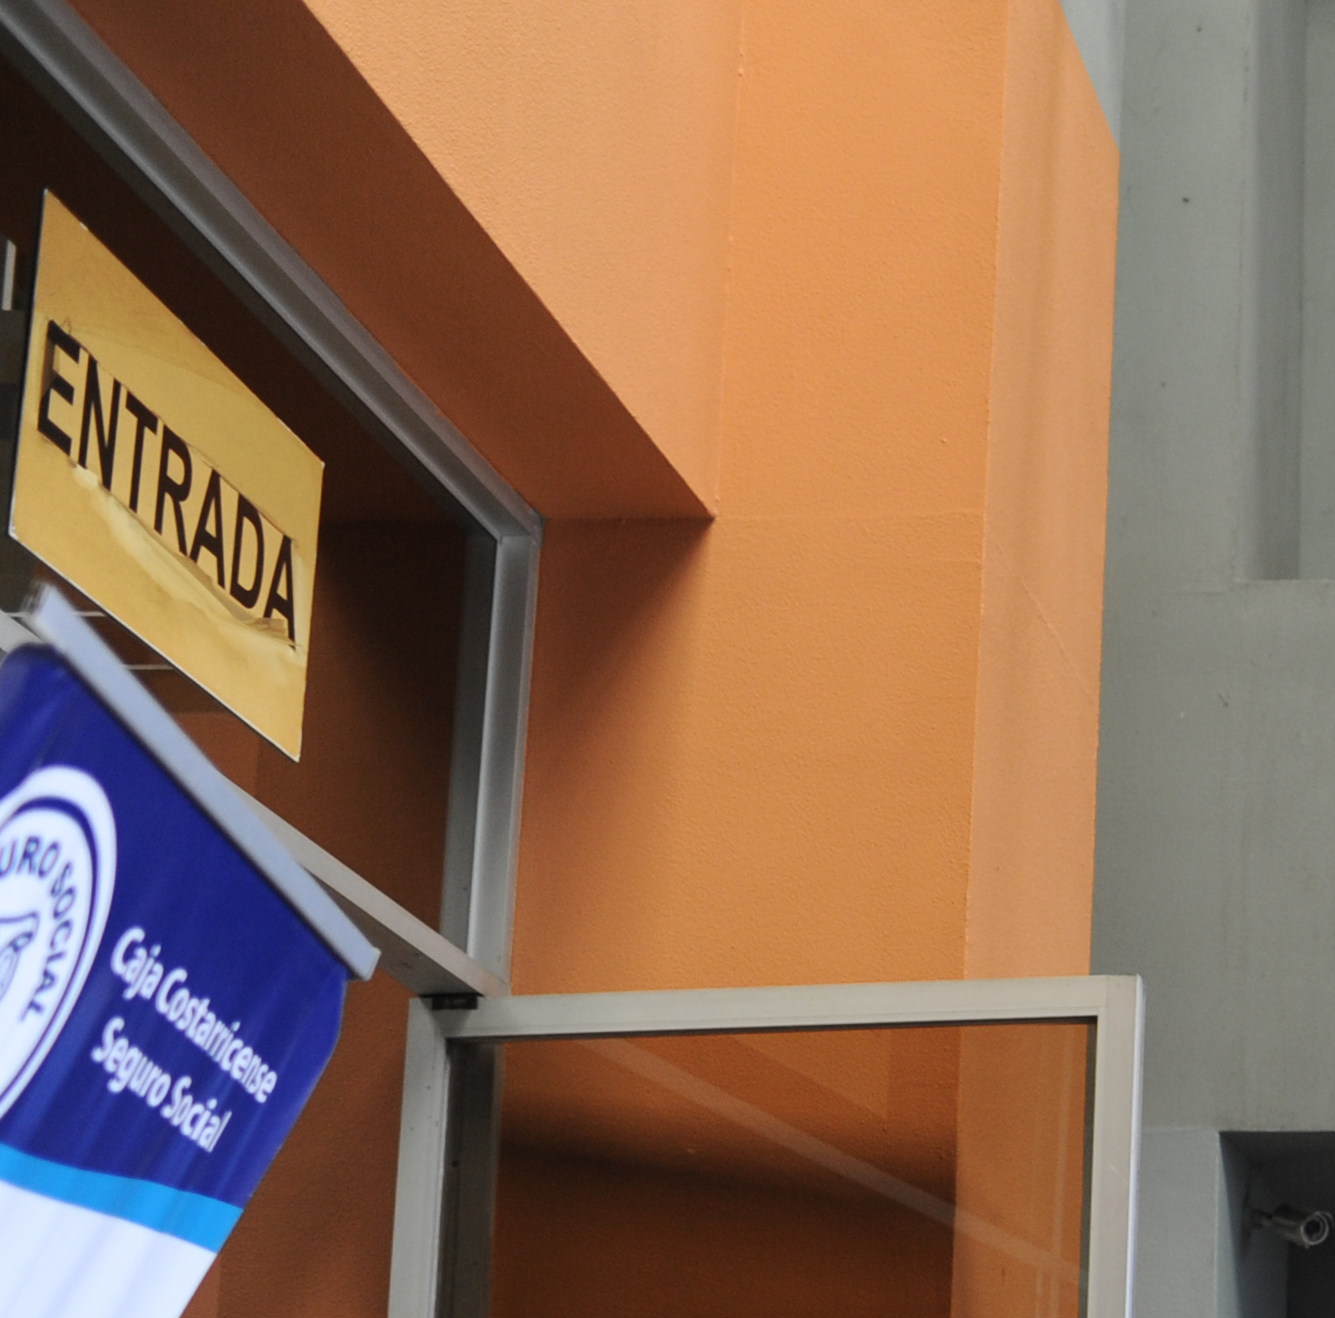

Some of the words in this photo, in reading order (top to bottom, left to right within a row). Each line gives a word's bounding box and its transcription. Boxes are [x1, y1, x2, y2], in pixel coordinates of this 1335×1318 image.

[37, 319, 297, 649] ENTRADA
[20, 862, 75, 1021] SOCIAL
[110, 926, 164, 1000] Caja
[155, 967, 277, 1104] Costarricense
[91, 1016, 171, 1108] Seguro
[160, 1075, 232, 1153] Social
